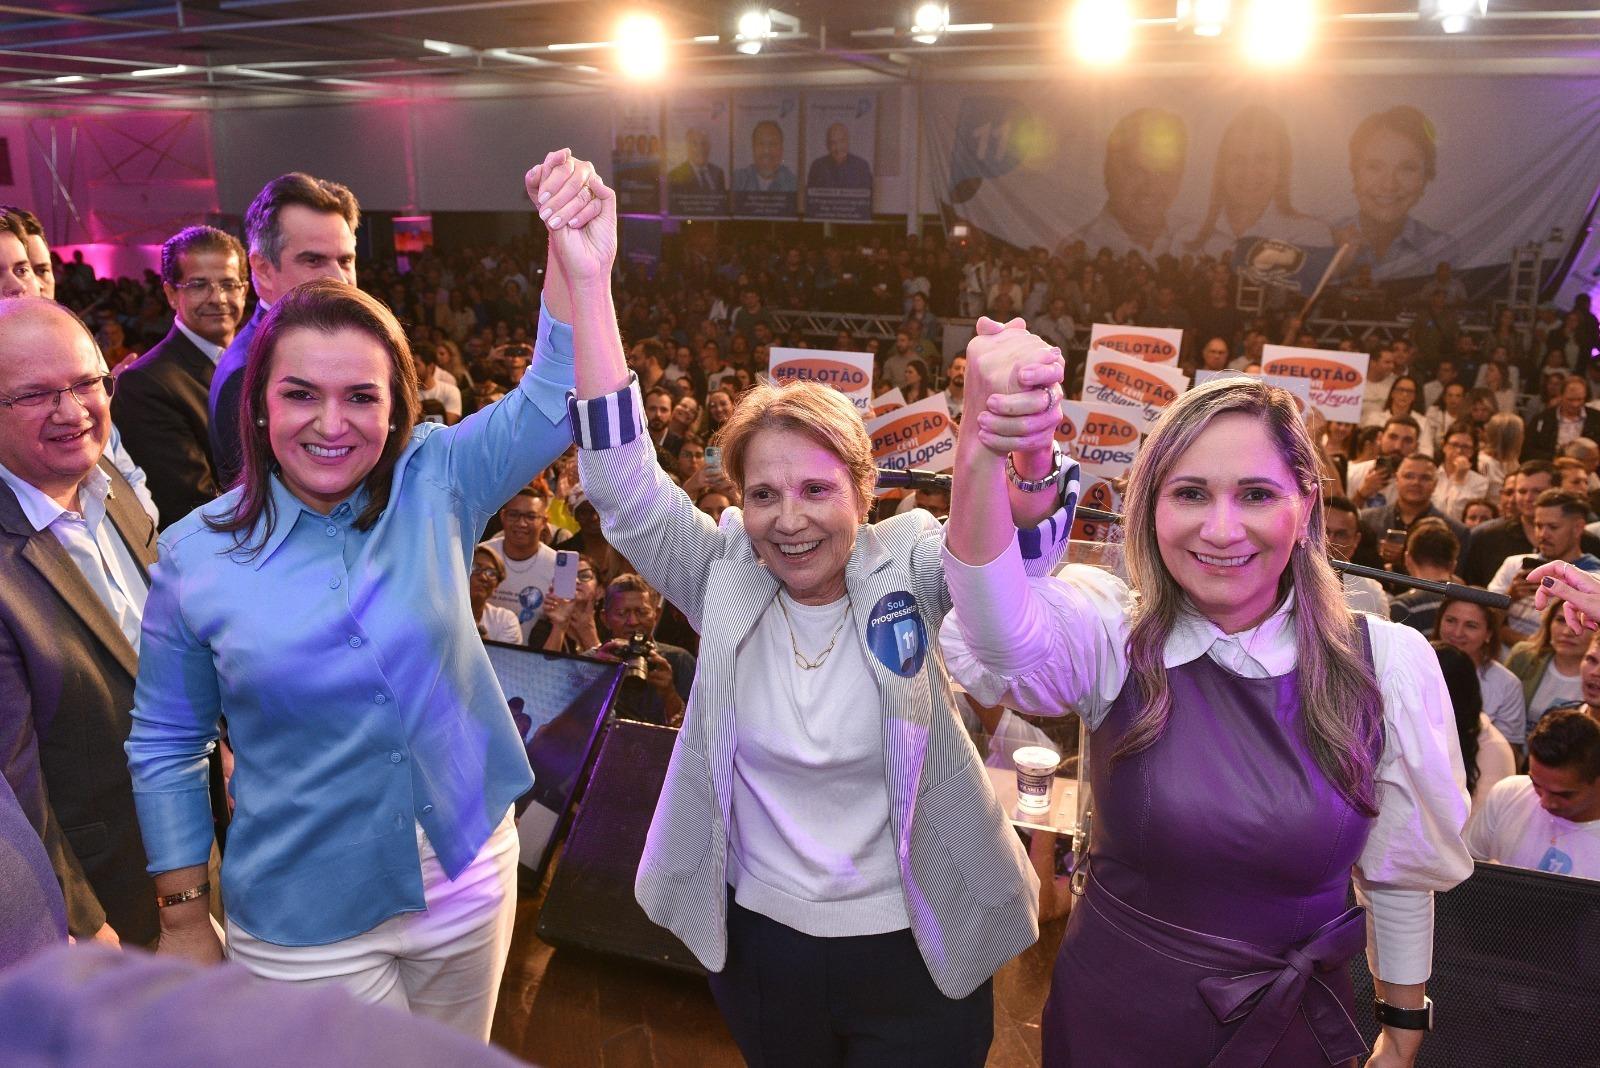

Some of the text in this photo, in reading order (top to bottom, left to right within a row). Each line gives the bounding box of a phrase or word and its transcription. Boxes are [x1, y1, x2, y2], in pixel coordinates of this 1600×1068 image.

[777, 367, 863, 383] #PELOTÃO
[1099, 366, 1175, 400] #PELOTÃO
[1269, 364, 1357, 382] #PELOTÃO
[873, 415, 943, 451] PELOTÃO
[1082, 422, 1132, 437] OTÃO
[908, 438, 953, 466] Lopes
[1081, 445, 1134, 465] Lopes
[887, 600, 905, 611] Sou
[902, 630, 915, 650] 11
